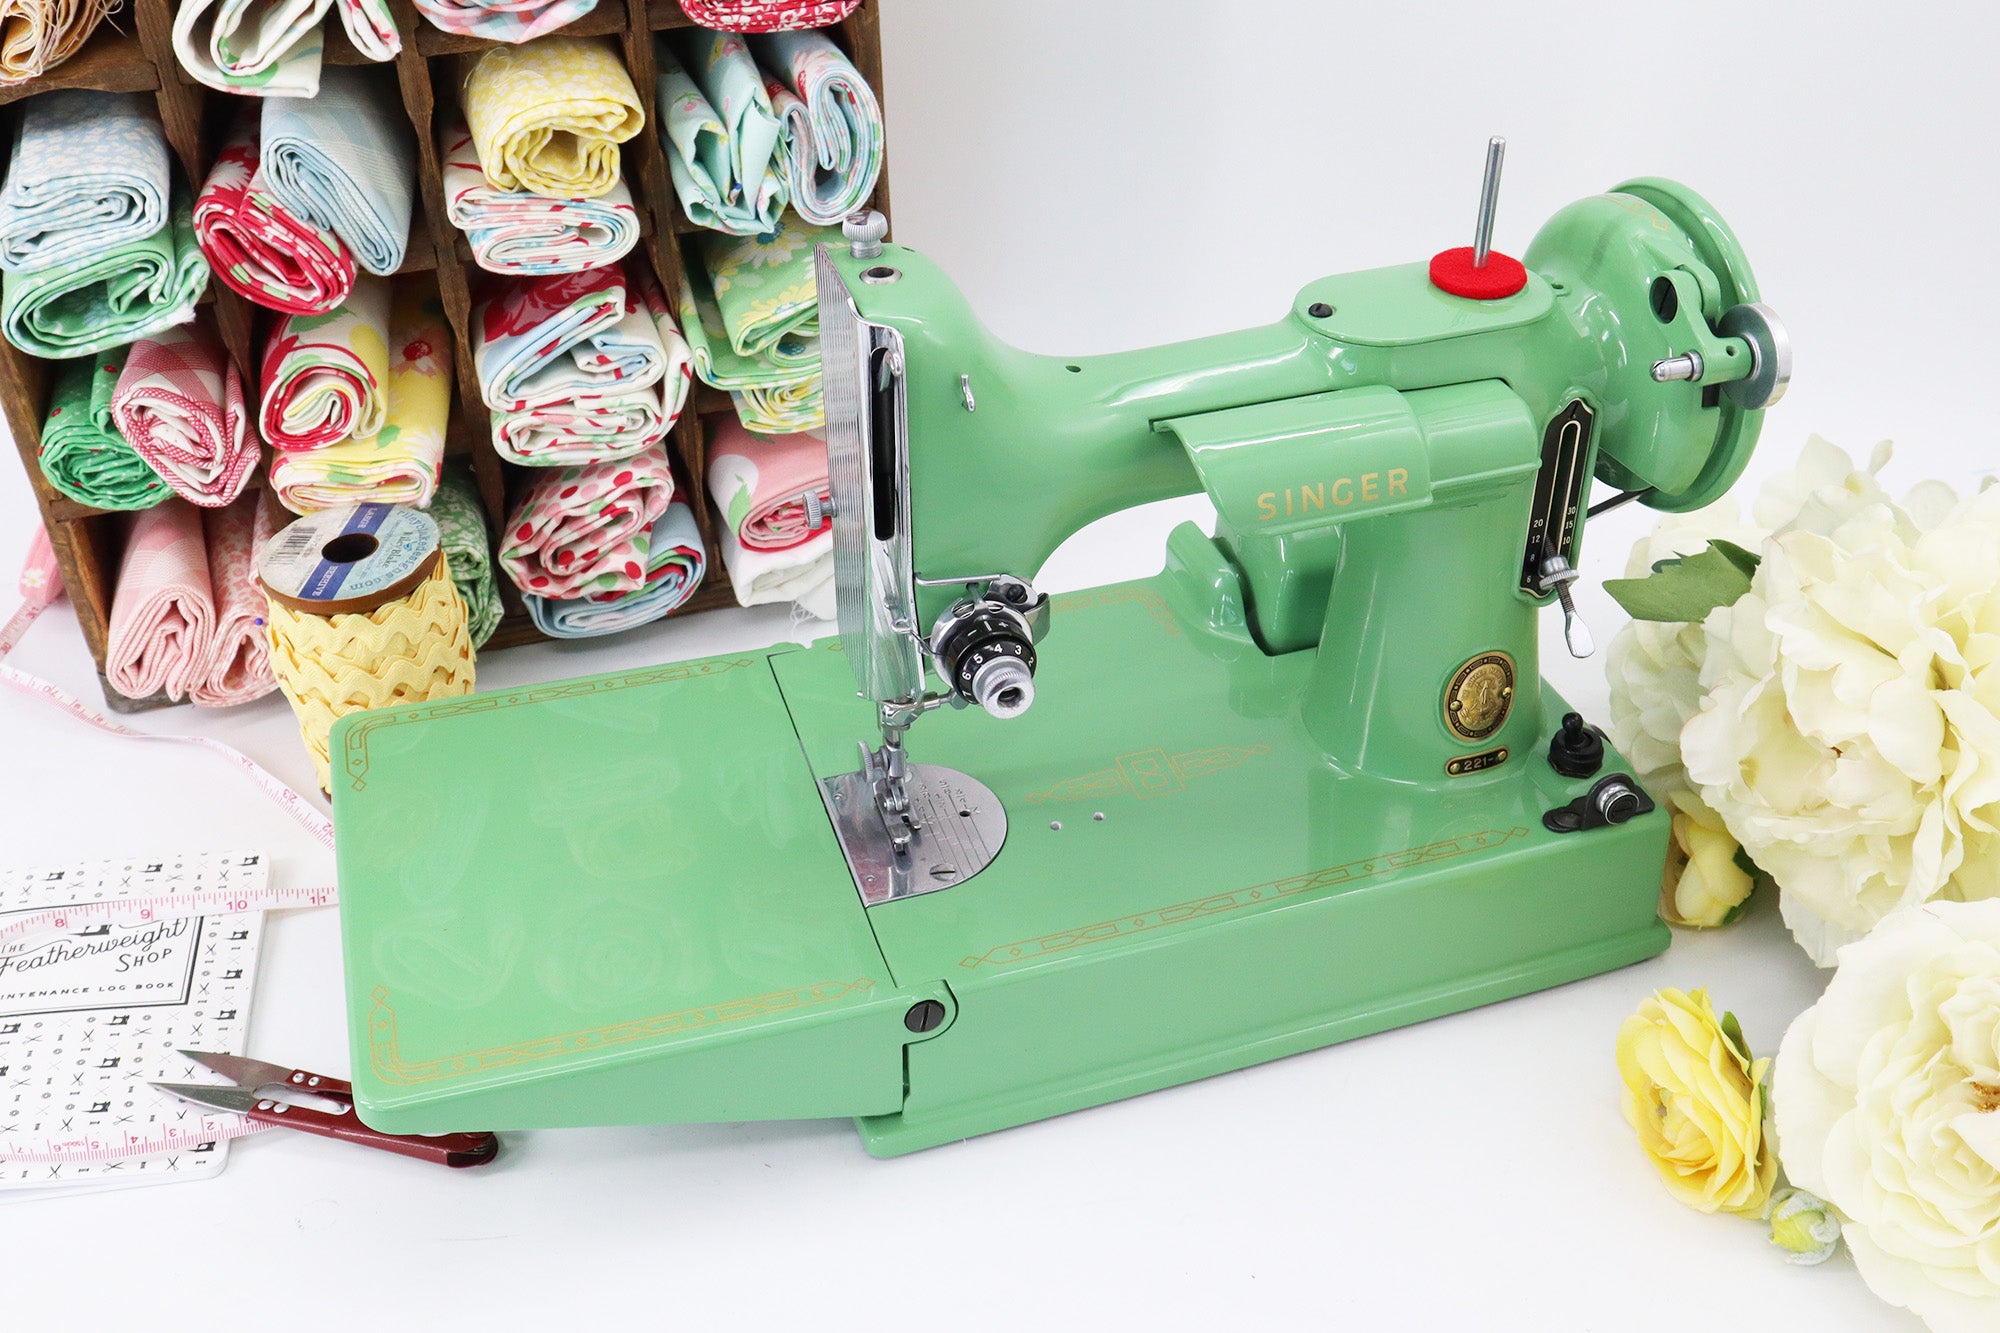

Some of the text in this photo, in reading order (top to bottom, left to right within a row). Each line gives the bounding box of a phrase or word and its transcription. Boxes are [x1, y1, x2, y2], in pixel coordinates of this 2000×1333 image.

[1256, 467, 1409, 521] SINGER
[1568, 506, 1576, 516] 30
[1533, 519, 1544, 528] 20
[1565, 521, 1574, 530] 15
[1531, 535, 1541, 544] 12
[1563, 536, 1571, 545] 10
[1526, 575, 1532, 583] 6
[962, 671, 972, 681] 6
[973, 653, 983, 664] 5
[994, 643, 1003, 653] 4
[1014, 644, 1022, 655] 3
[1028, 656, 1034, 666] 2
[54, 895, 327, 927] 8 9 10 11
[0, 917, 188, 977] Featherweight
[115, 948, 173, 973] SHOP
[100, 984, 126, 992] LOG
[135, 982, 175, 990] BOOK
[207, 1121, 215, 1131] 2
[169, 1128, 177, 1137] 3
[130, 1135, 139, 1144] 4
[53, 1144, 61, 1152] 6
[91, 1141, 99, 1149] 5
